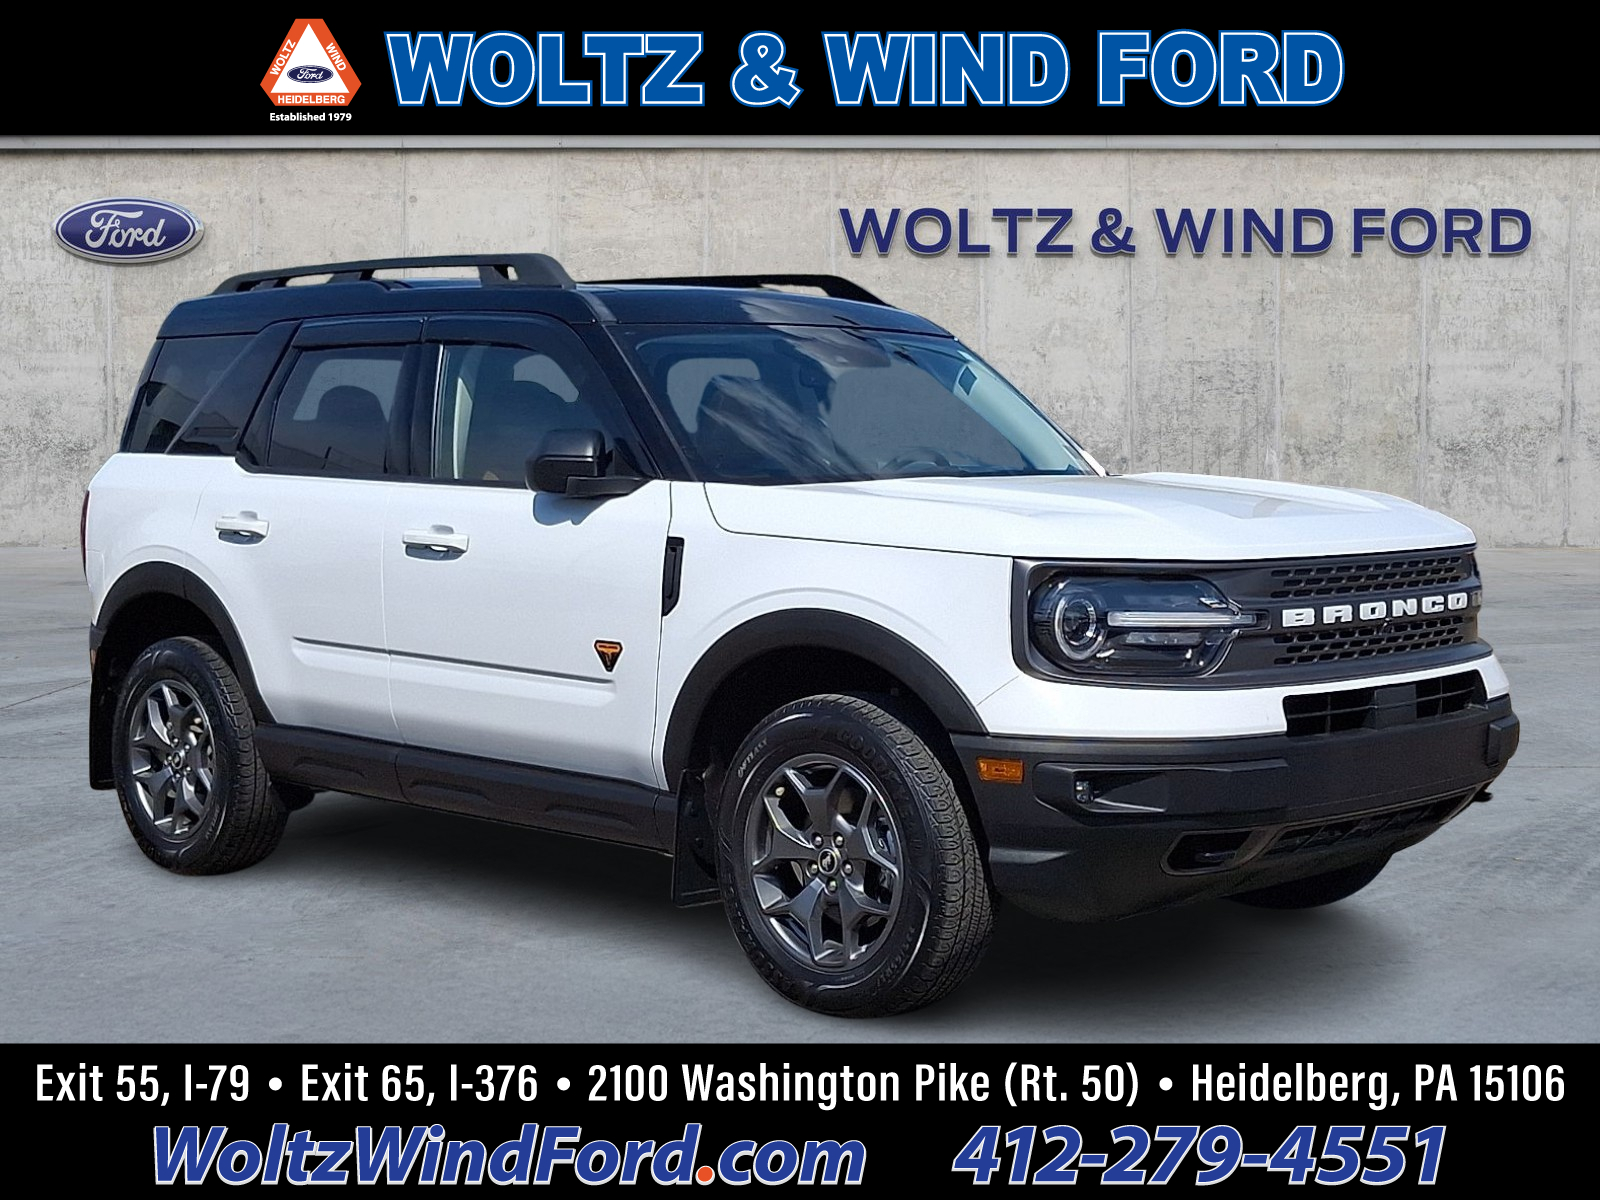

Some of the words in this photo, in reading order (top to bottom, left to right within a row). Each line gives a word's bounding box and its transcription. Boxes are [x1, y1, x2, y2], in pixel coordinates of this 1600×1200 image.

[85, 209, 166, 248] Ford
[839, 207, 1074, 255] WOLTZ
[1091, 207, 1137, 255] &
[1156, 207, 1334, 255] WIND
[1352, 207, 1533, 255] FORD
[1281, 592, 1468, 628] BRONCO
